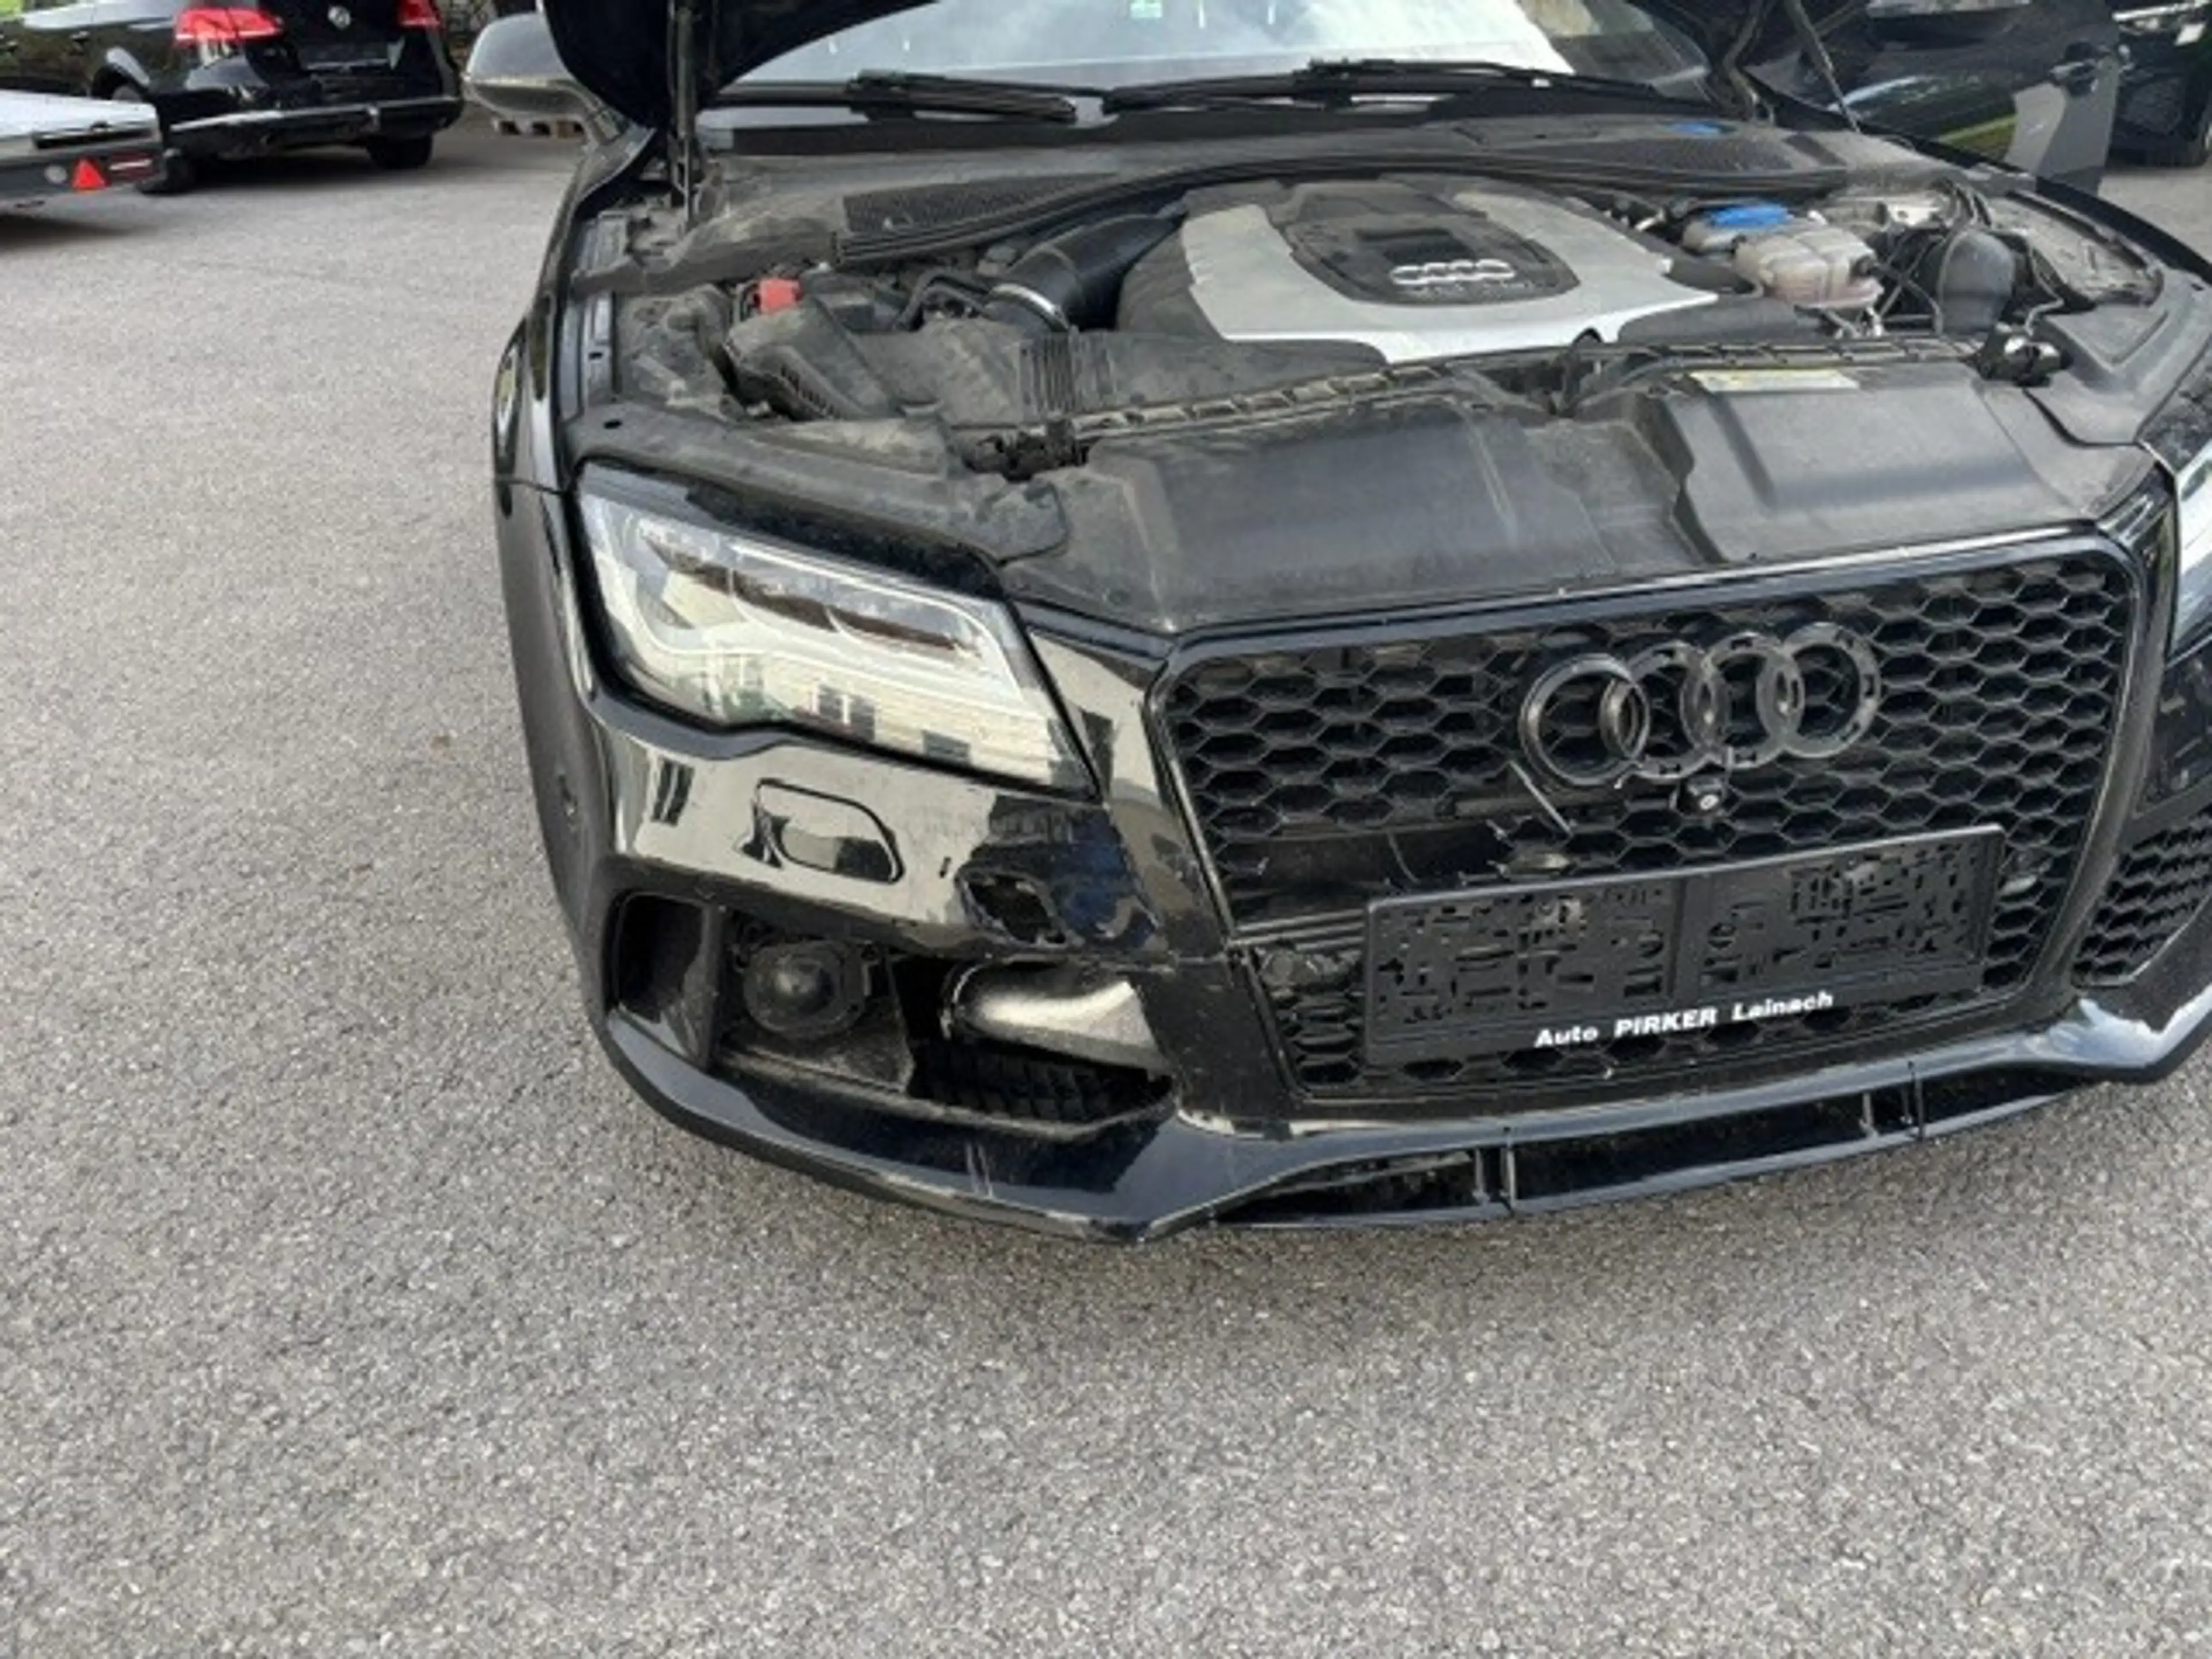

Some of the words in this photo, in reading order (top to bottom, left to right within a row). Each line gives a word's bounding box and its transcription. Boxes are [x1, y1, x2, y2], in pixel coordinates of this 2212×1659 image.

[1534, 1025, 1599, 1048] Auto
[1614, 1007, 1718, 1037] PIRKER
[1731, 990, 1834, 1021] Lainach
